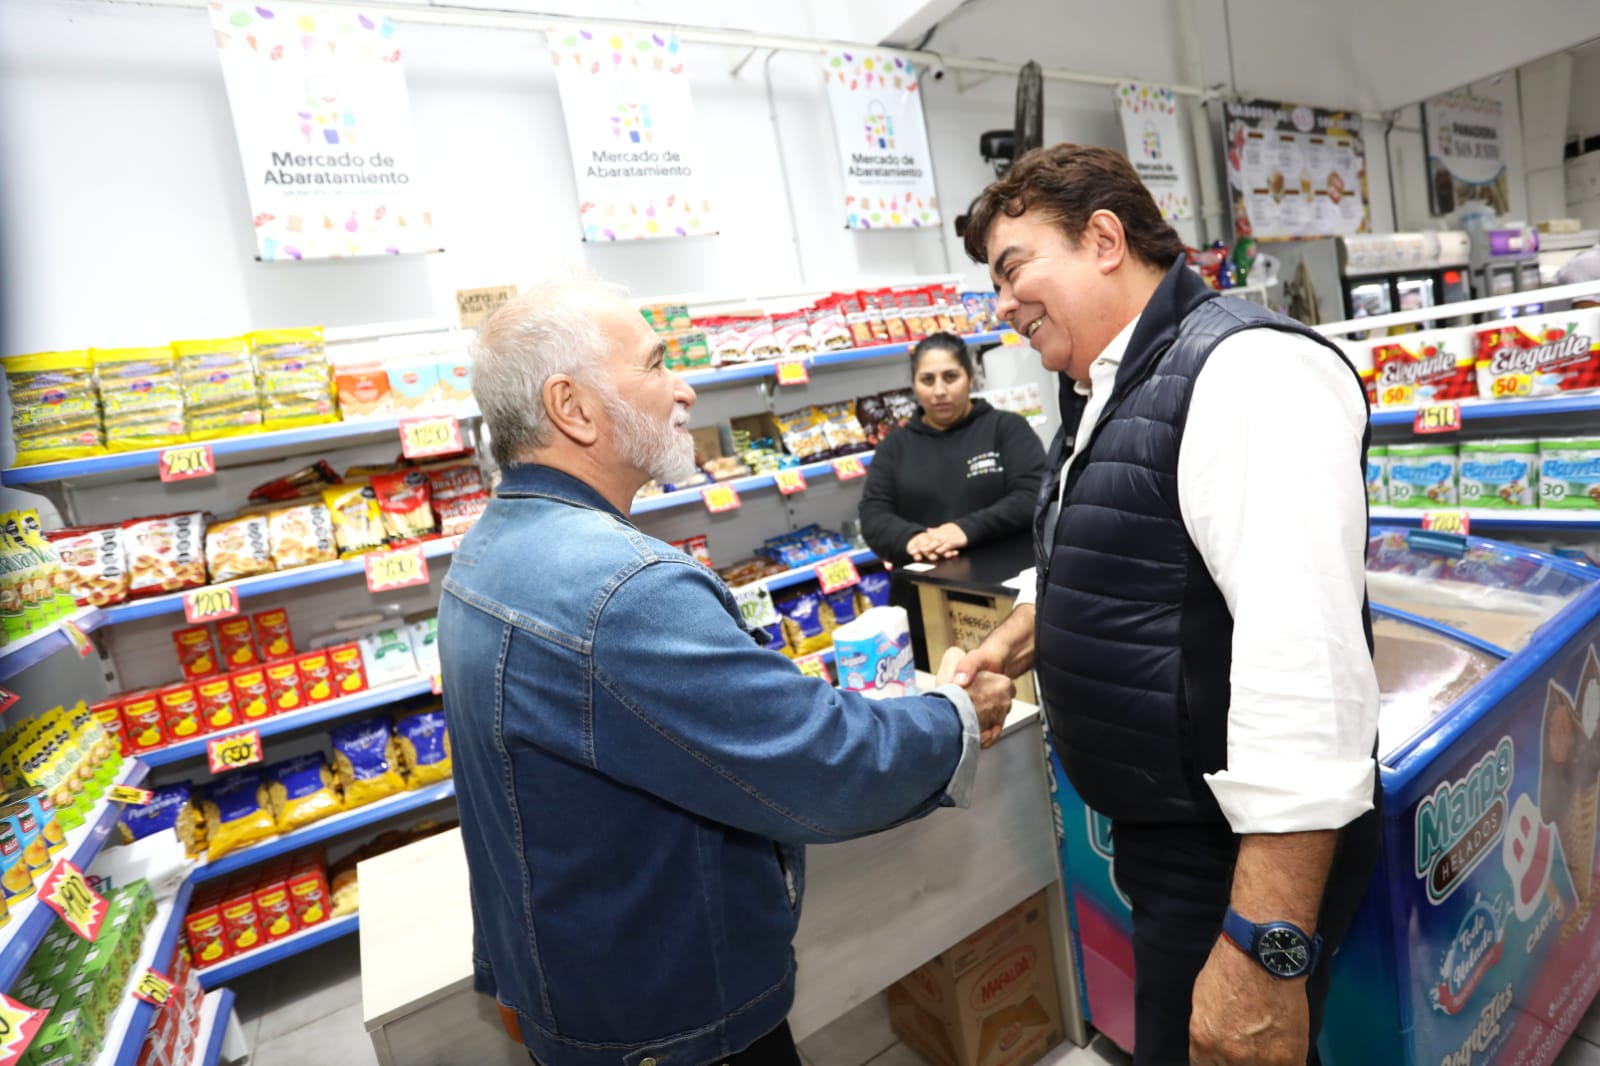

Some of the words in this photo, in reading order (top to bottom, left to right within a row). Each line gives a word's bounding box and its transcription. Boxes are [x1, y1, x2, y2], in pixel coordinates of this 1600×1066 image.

[271, 151, 365, 168] Mercado
[369, 152, 395, 168] de
[592, 150, 659, 163] Mercado
[662, 149, 681, 162] de
[851, 153, 899, 165] Mercado
[902, 154, 915, 166] de
[263, 169, 410, 185] Abaratamiento
[586, 164, 692, 178] Abaratamiento
[848, 165, 924, 178] Abaratamiento
[1489, 333, 1592, 376] Elegante
[1380, 352, 1456, 386] Elegante
[1495, 377, 1518, 394] 50
[1386, 386, 1404, 403] 50
[1543, 483, 1565, 498] 30
[1418, 740, 1513, 872] Marpe
[1441, 812, 1498, 881] HELADOS
